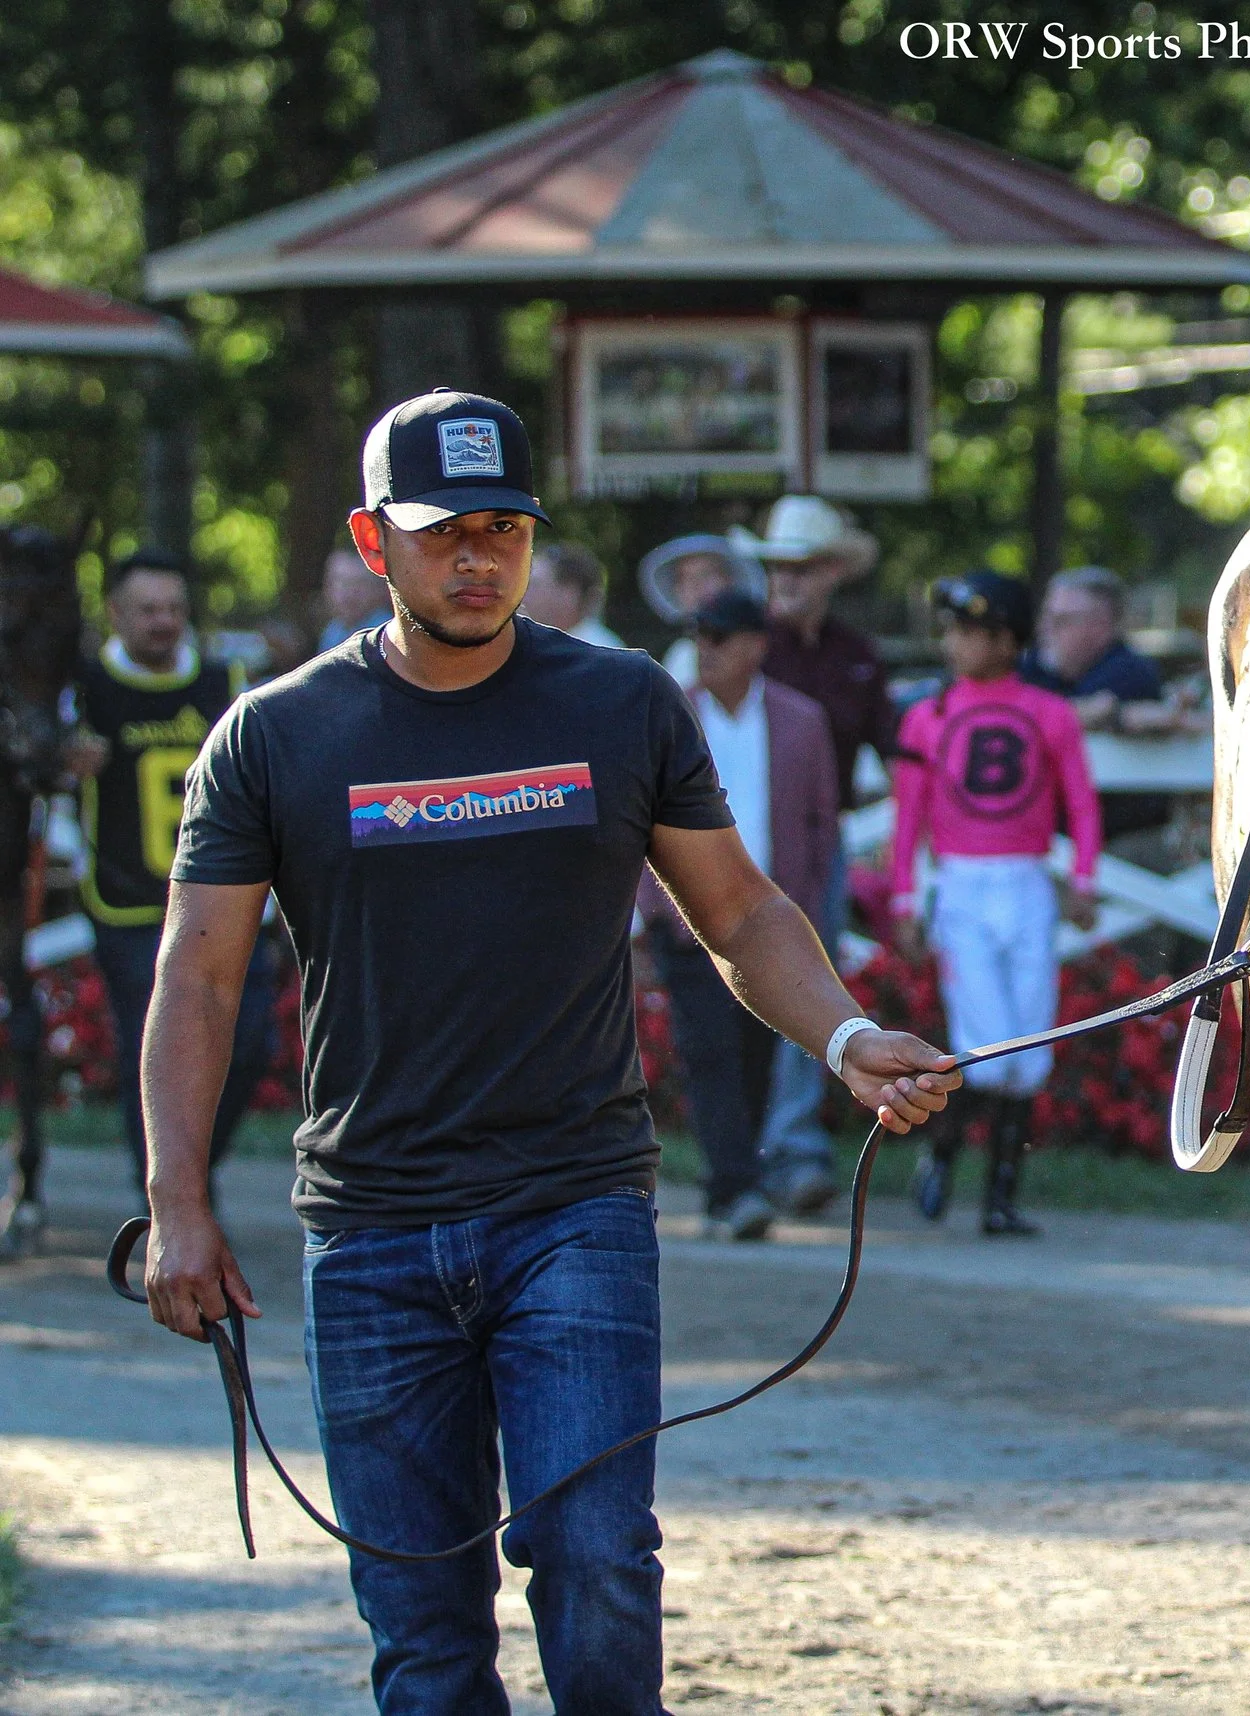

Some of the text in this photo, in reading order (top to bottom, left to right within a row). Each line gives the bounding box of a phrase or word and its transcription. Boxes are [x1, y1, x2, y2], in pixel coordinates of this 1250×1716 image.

[446, 427, 492, 437] HURLEY
[966, 728, 1026, 795] B
[419, 783, 566, 822] Columbia
